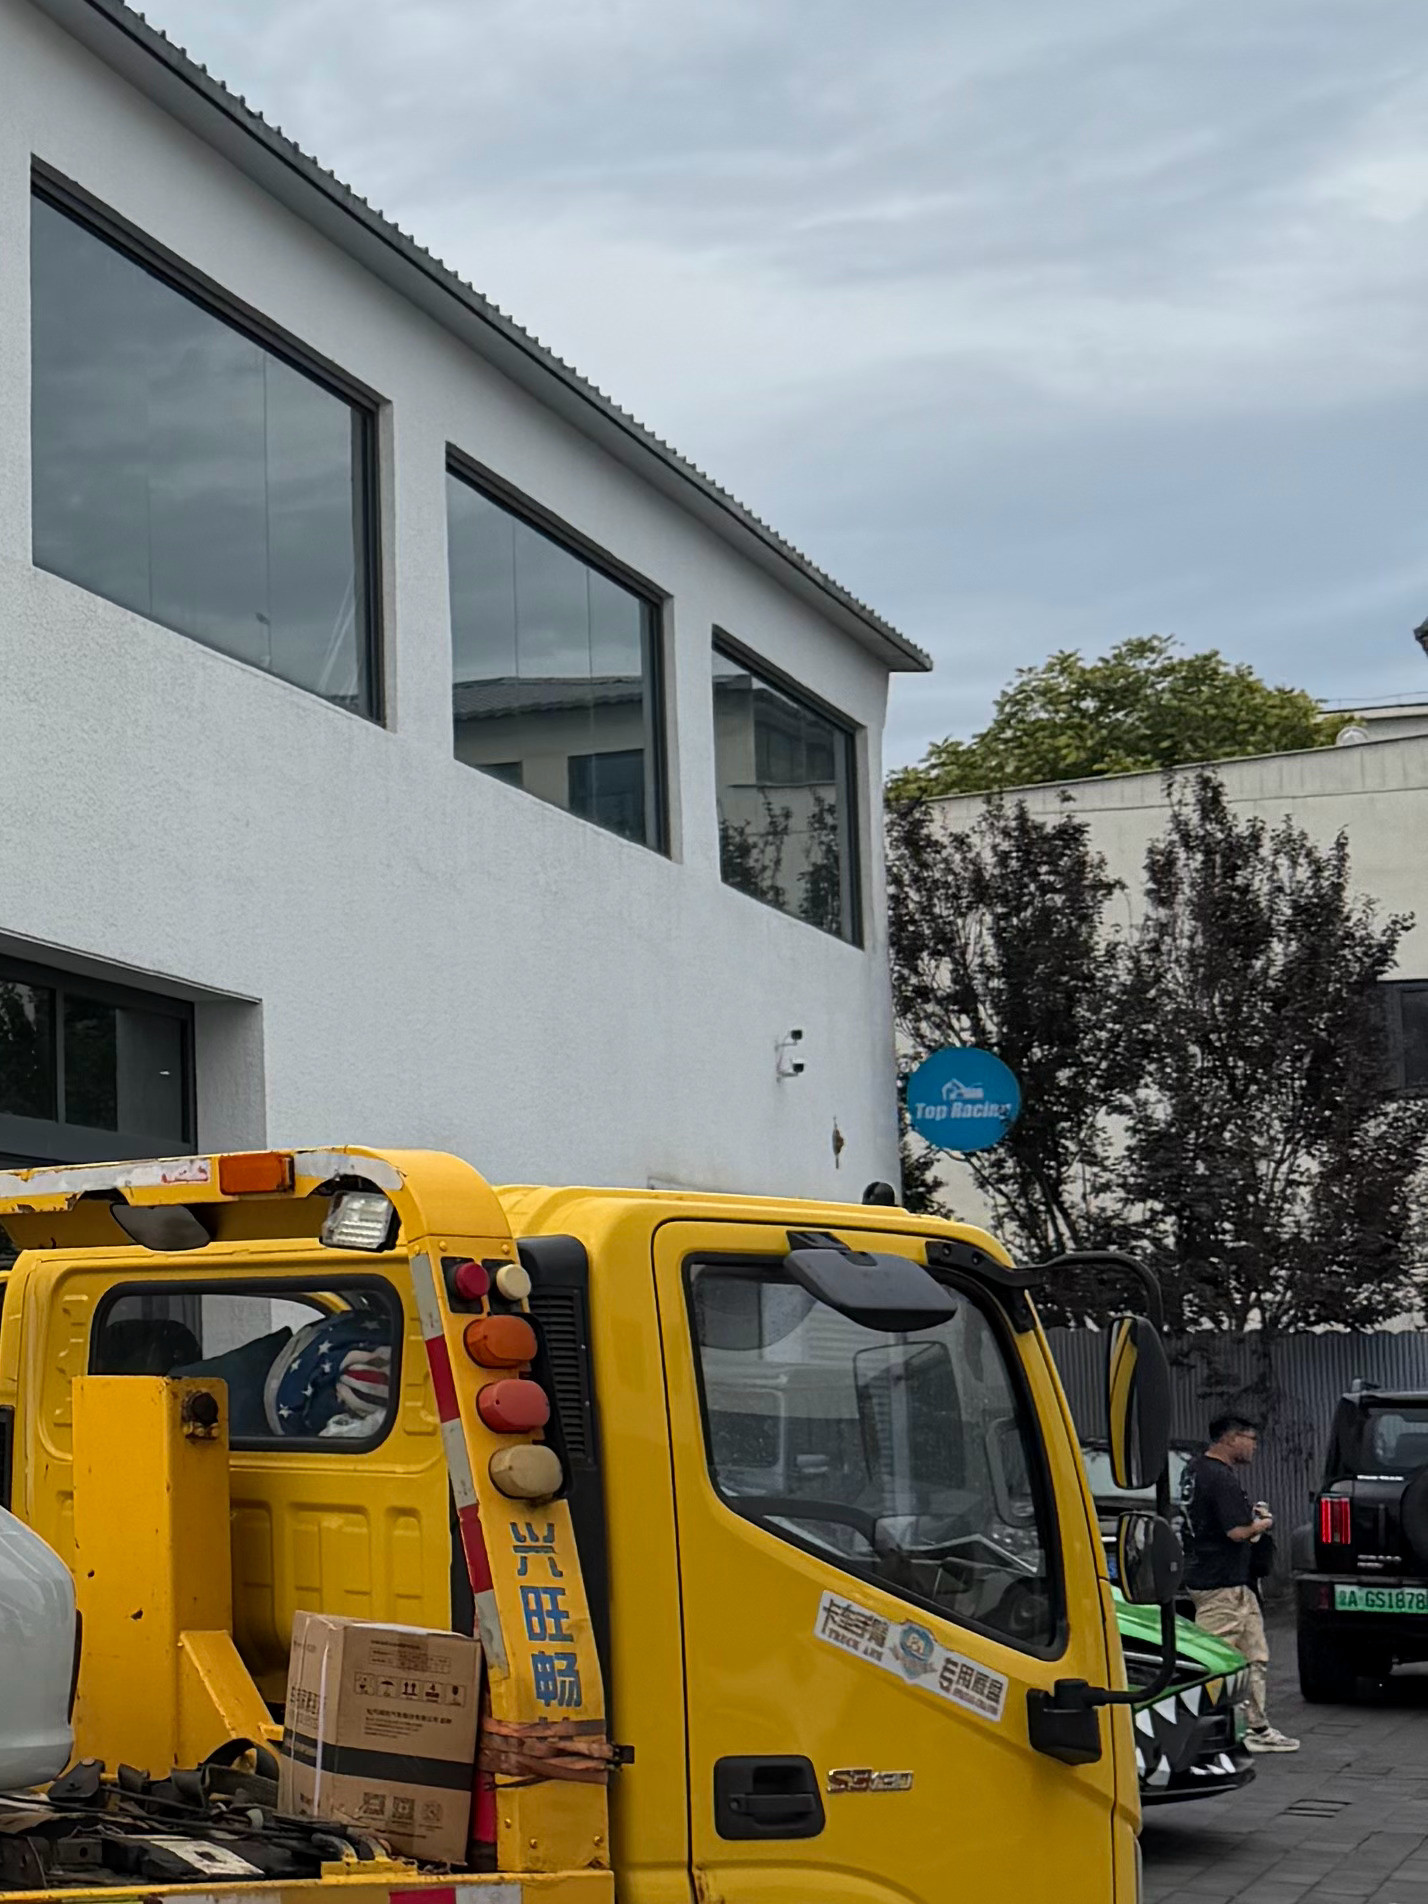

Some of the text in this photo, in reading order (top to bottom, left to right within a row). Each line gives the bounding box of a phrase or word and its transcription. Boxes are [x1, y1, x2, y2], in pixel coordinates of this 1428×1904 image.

[915, 1100, 1012, 1121] Top Racing
[509, 1521, 582, 1723] 兴旺畅
